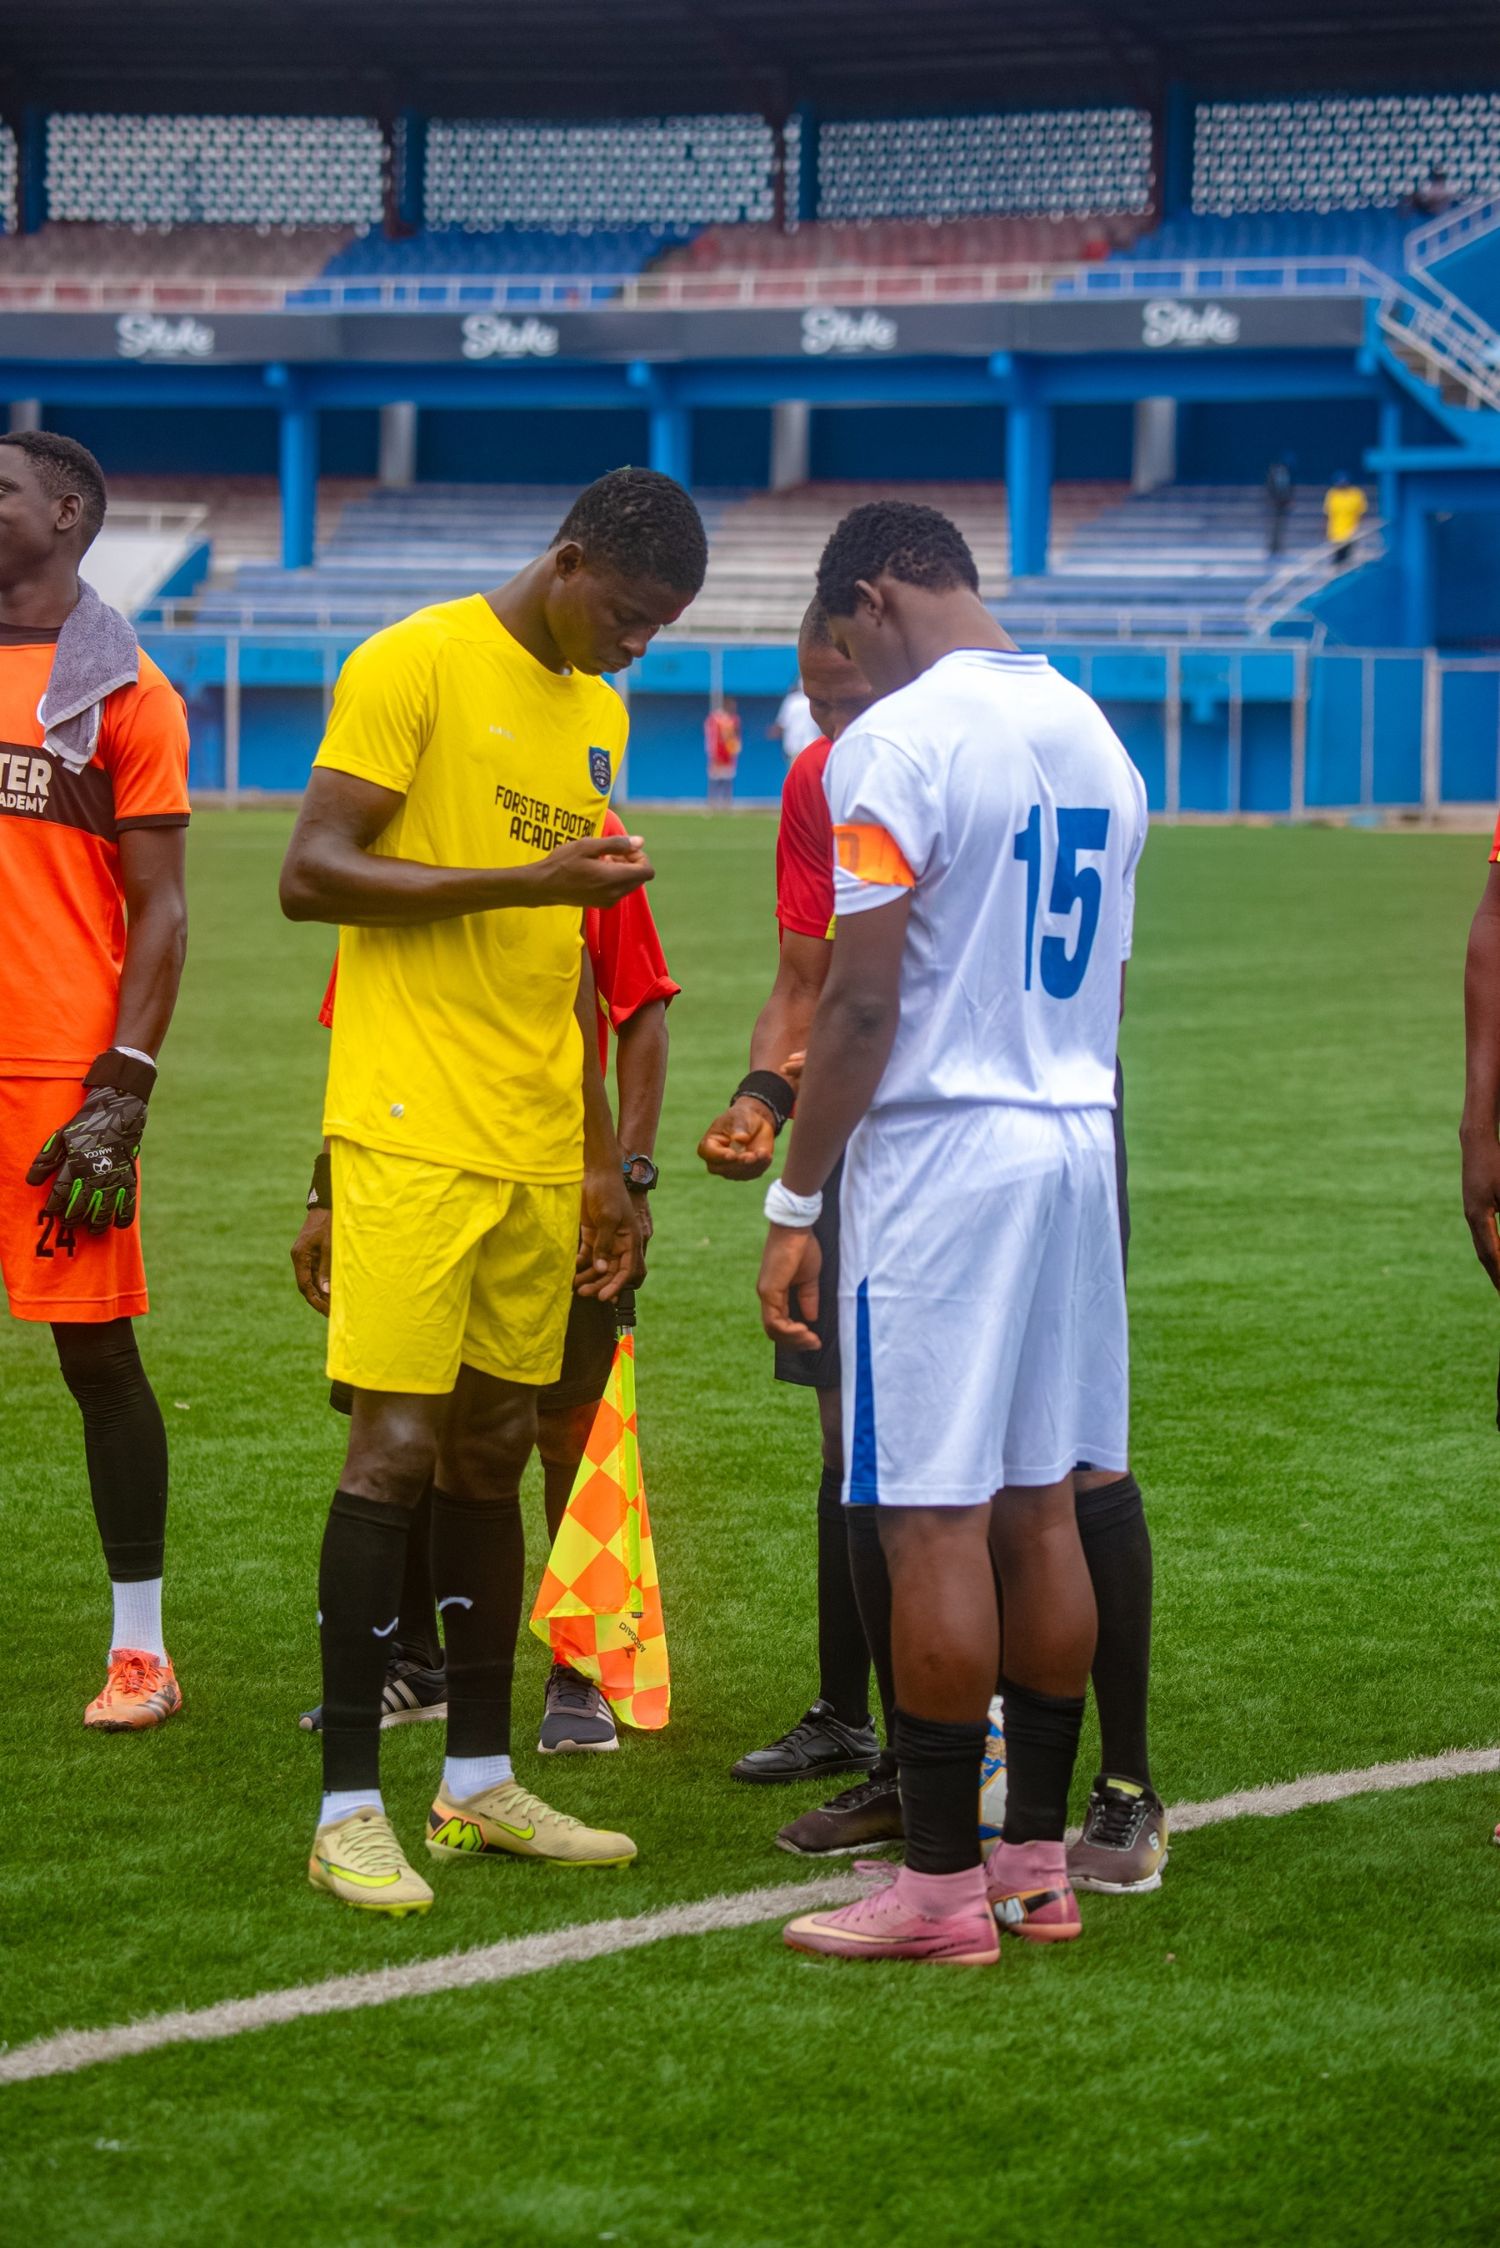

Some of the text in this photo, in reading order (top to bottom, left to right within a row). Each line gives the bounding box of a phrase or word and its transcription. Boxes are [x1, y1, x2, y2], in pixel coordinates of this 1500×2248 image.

[495, 785, 550, 825] FORSTER
[510, 816, 577, 851] ACADE
[1014, 804, 1110, 999] 15
[36, 1209, 76, 1257] 24
